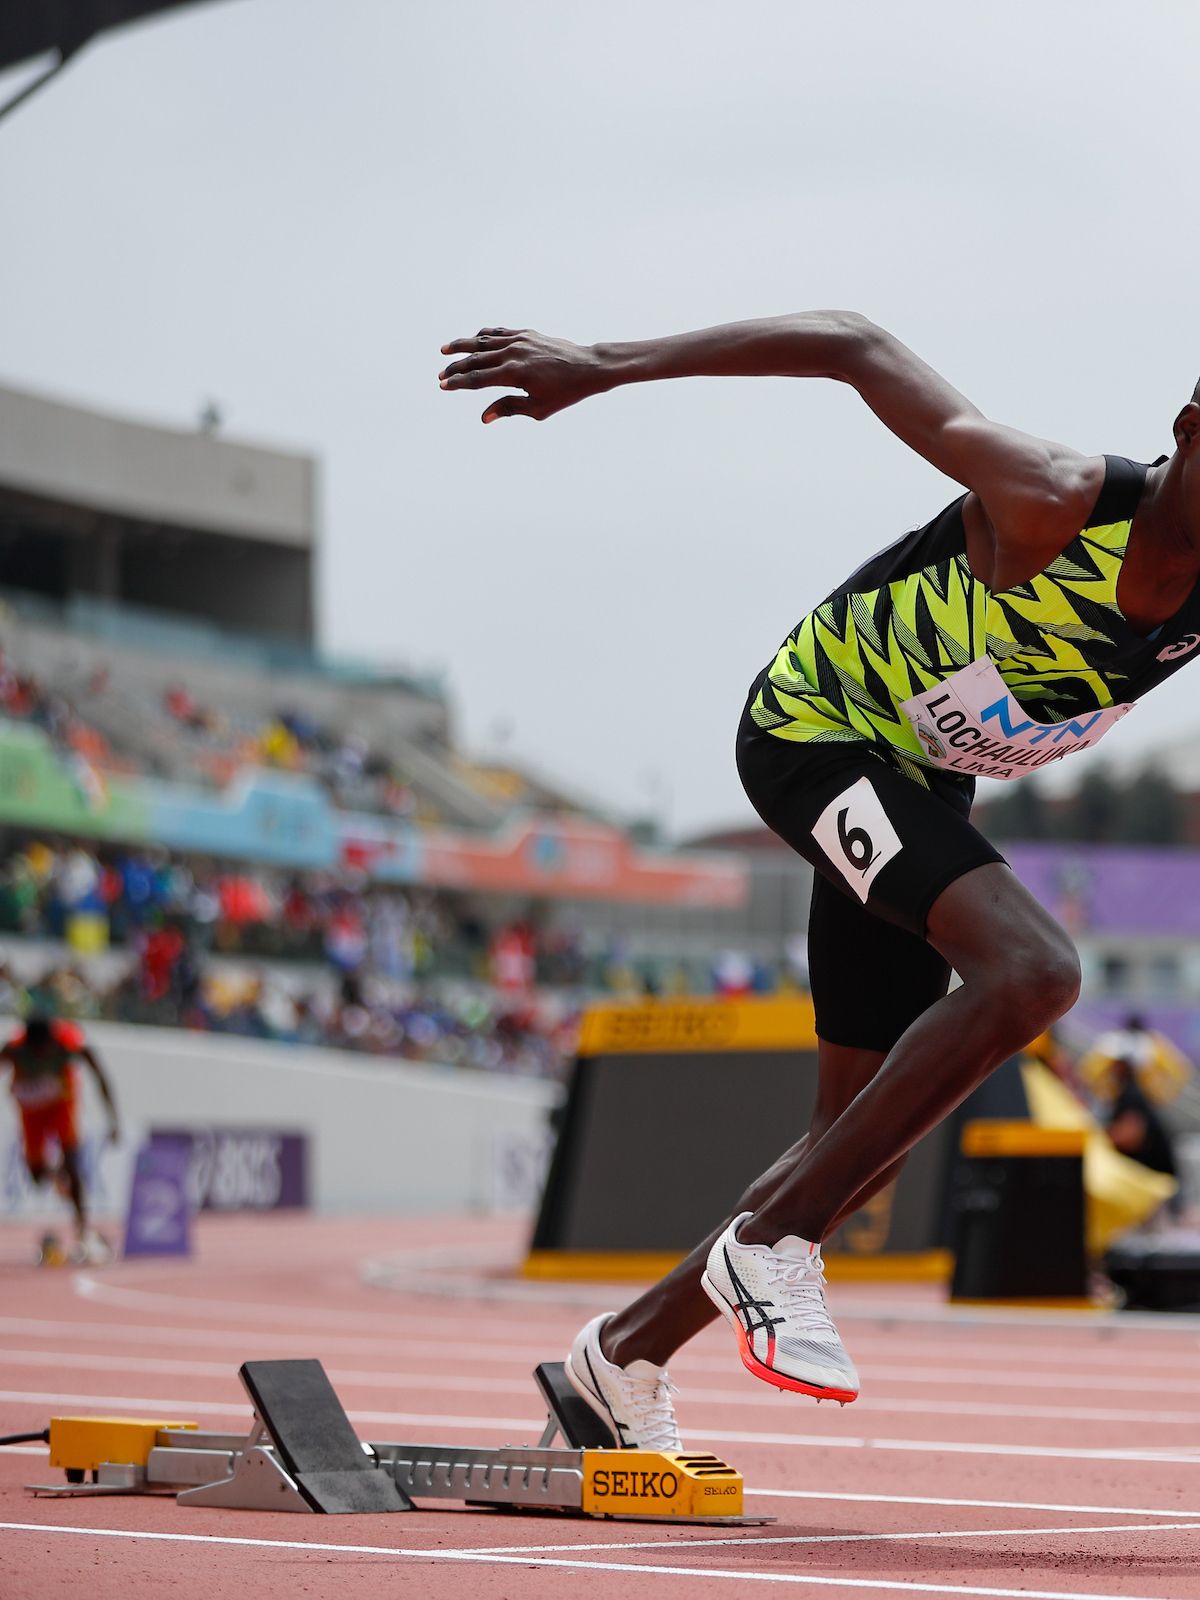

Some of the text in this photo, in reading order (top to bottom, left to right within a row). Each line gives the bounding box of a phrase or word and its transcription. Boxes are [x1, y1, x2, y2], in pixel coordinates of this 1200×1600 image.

[980, 695, 1103, 746] NTN
[948, 757, 1014, 778] LIMA
[837, 806, 874, 871] 6
[593, 1470, 678, 1499] SEIKO
[704, 1486, 737, 1496] SEIKO
